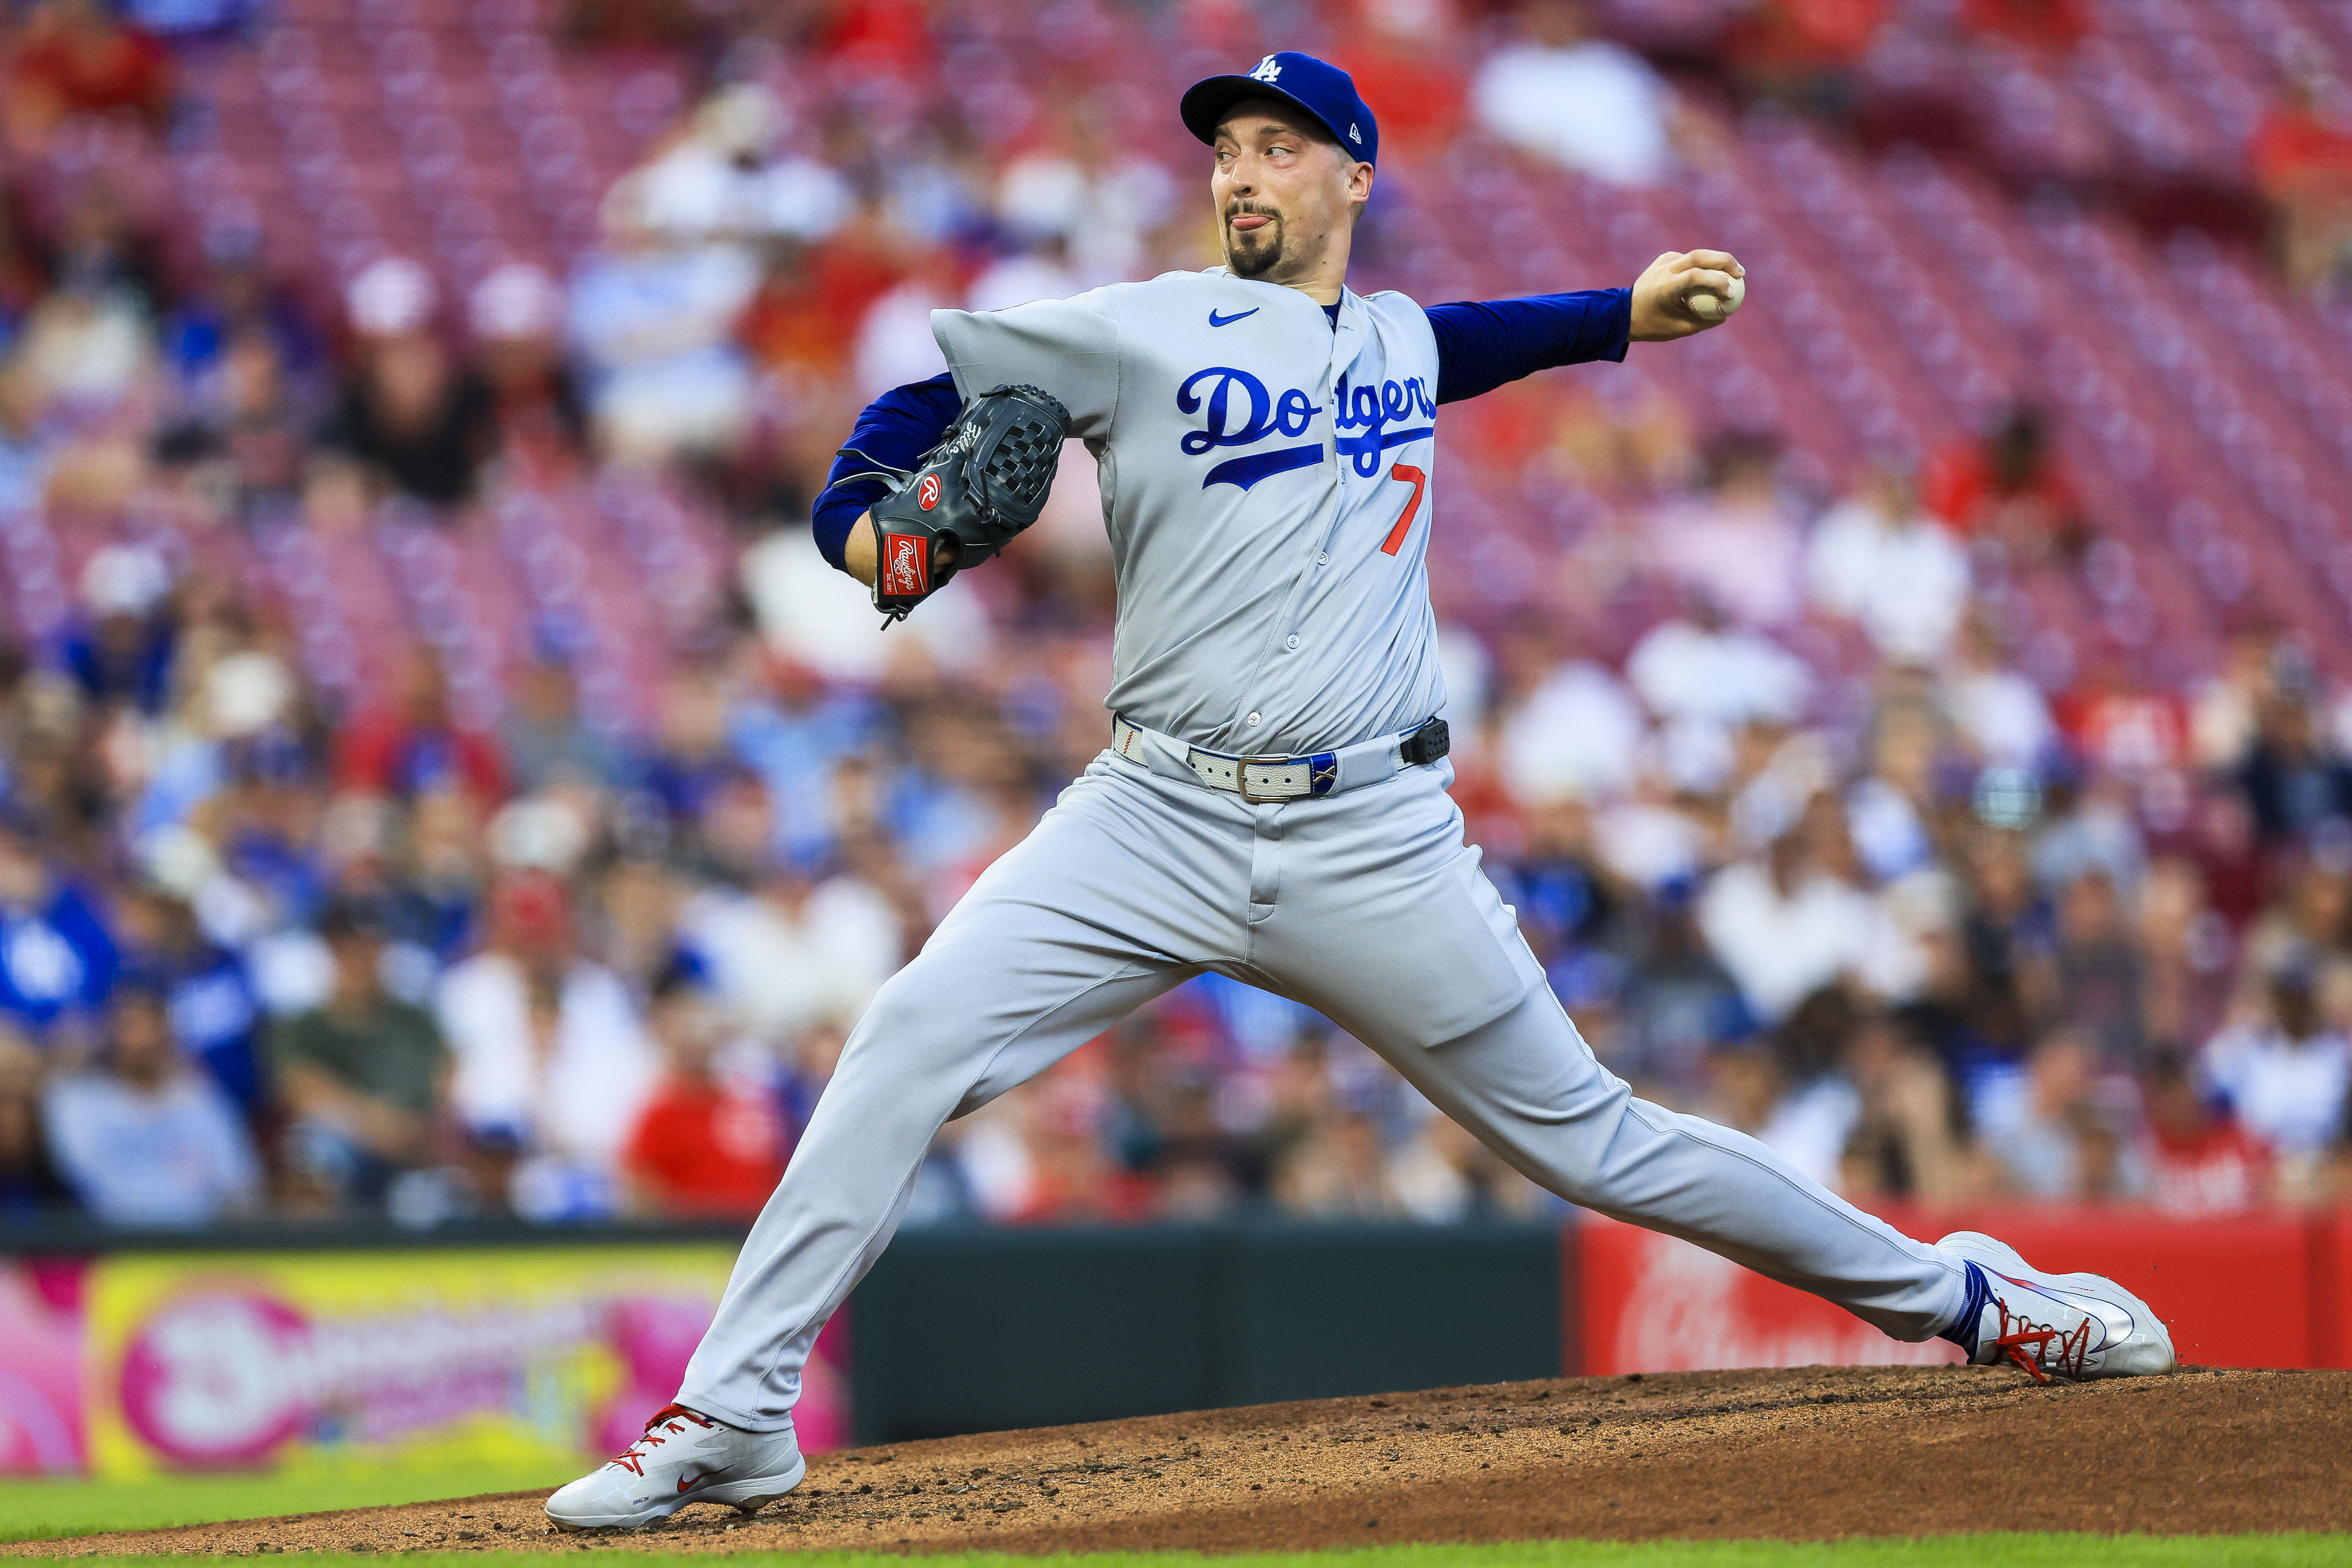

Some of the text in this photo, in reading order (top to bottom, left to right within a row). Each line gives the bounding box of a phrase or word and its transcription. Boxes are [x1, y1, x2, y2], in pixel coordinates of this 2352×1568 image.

[1250, 54, 1282, 82] LA
[921, 476, 939, 505] R
[1380, 463, 1426, 556] 7
[899, 540, 916, 591] Rawlings
